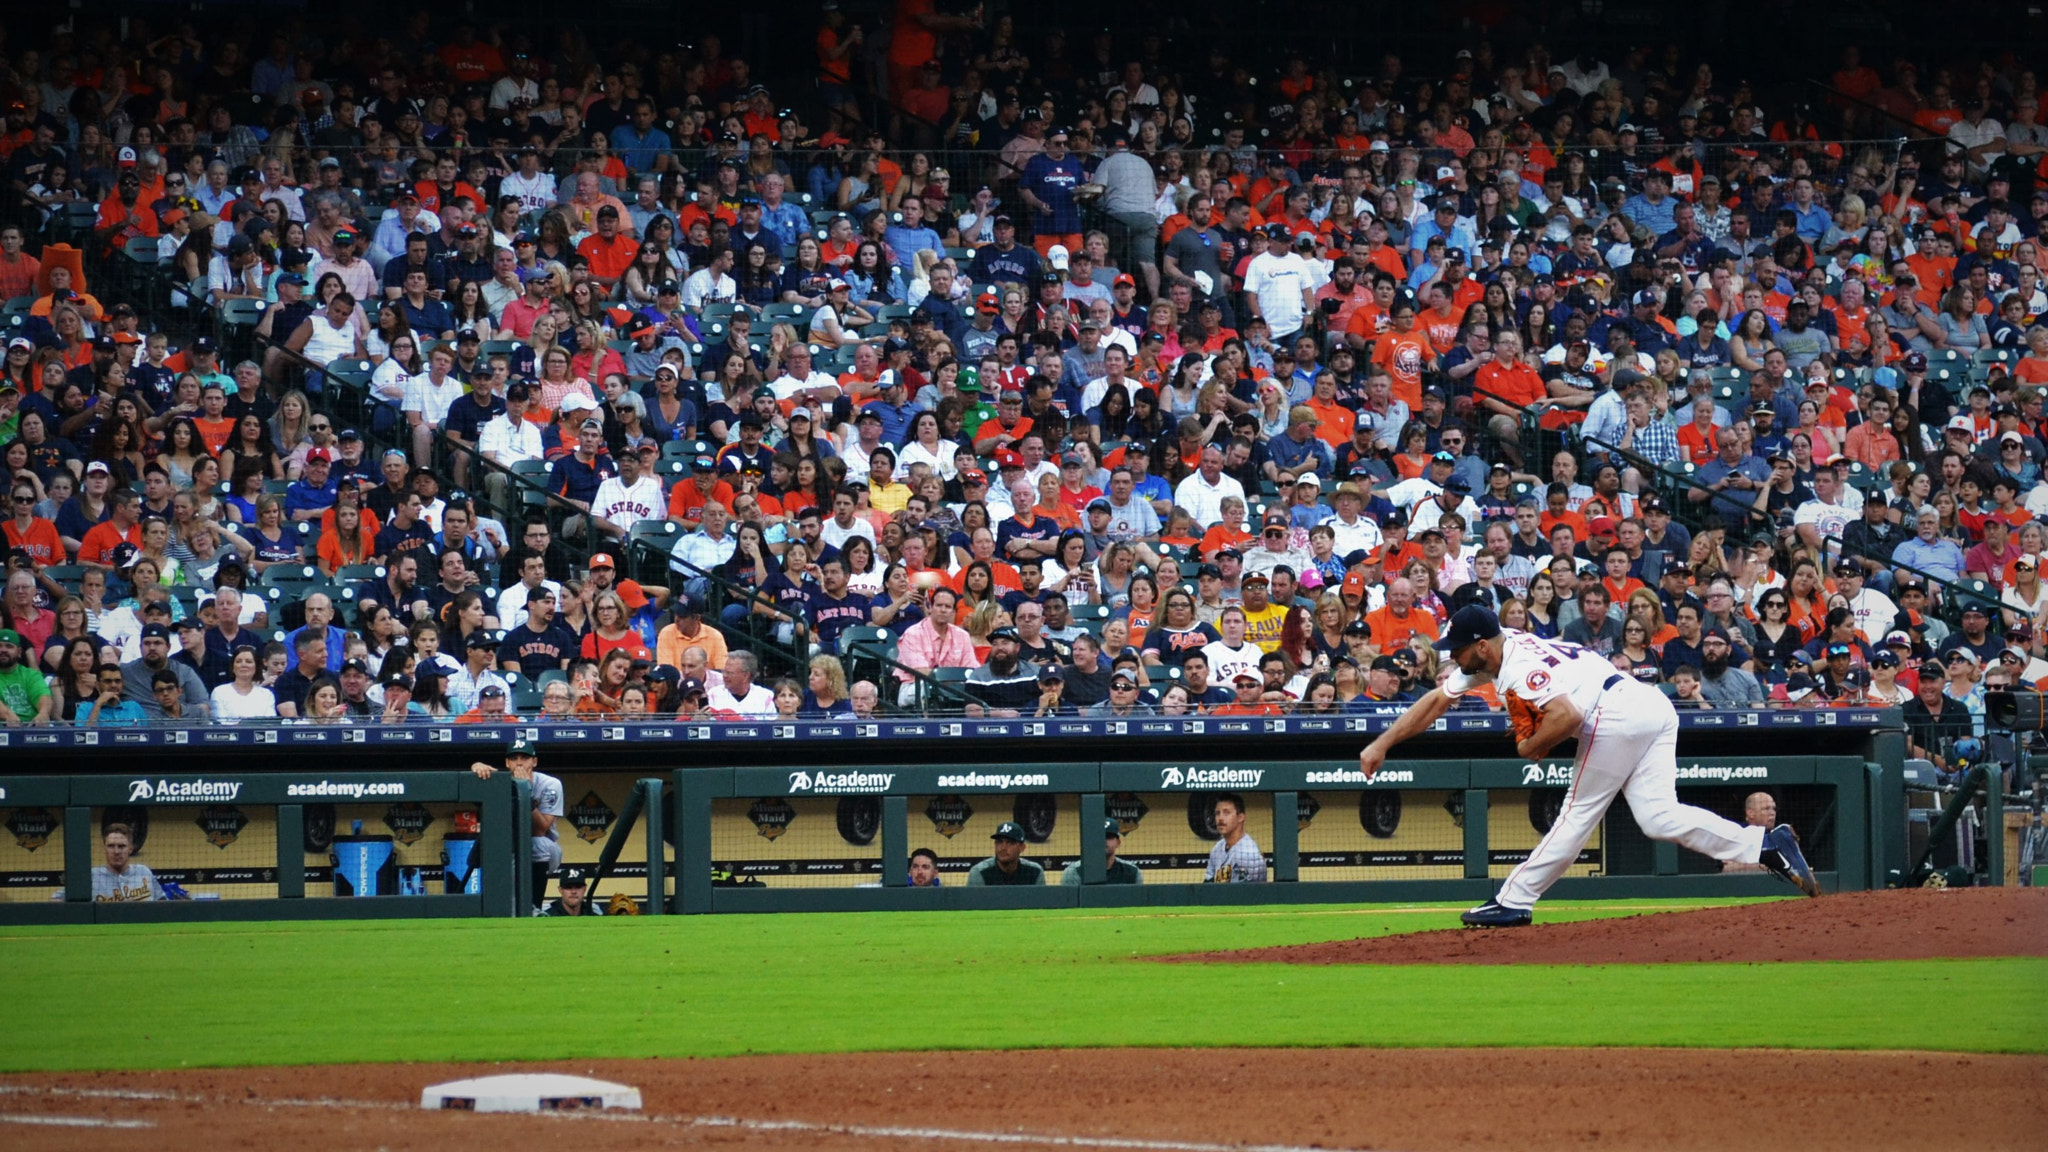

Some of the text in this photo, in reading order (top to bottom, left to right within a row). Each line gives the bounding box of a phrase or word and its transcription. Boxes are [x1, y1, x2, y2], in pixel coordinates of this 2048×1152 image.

[987, 260, 1025, 276] ASTROS
[604, 501, 651, 519] ASTROS
[1247, 615, 1282, 632] EAUX
[518, 642, 560, 658] ASTROS
[938, 771, 1048, 789] academy.com
[1186, 766, 1262, 786] Academy
[1675, 764, 1768, 780] cademy.com
[814, 771, 893, 790] Academy
[156, 779, 239, 800] Academy
[288, 780, 404, 798] academy.com
[577, 815, 606, 825] Maid
[758, 813, 785, 822] Maid
[936, 811, 963, 820] Maid
[1112, 808, 1138, 818] Maid
[17, 823, 47, 832] Maid
[207, 820, 237, 830] Maid
[394, 818, 423, 827] Maid
